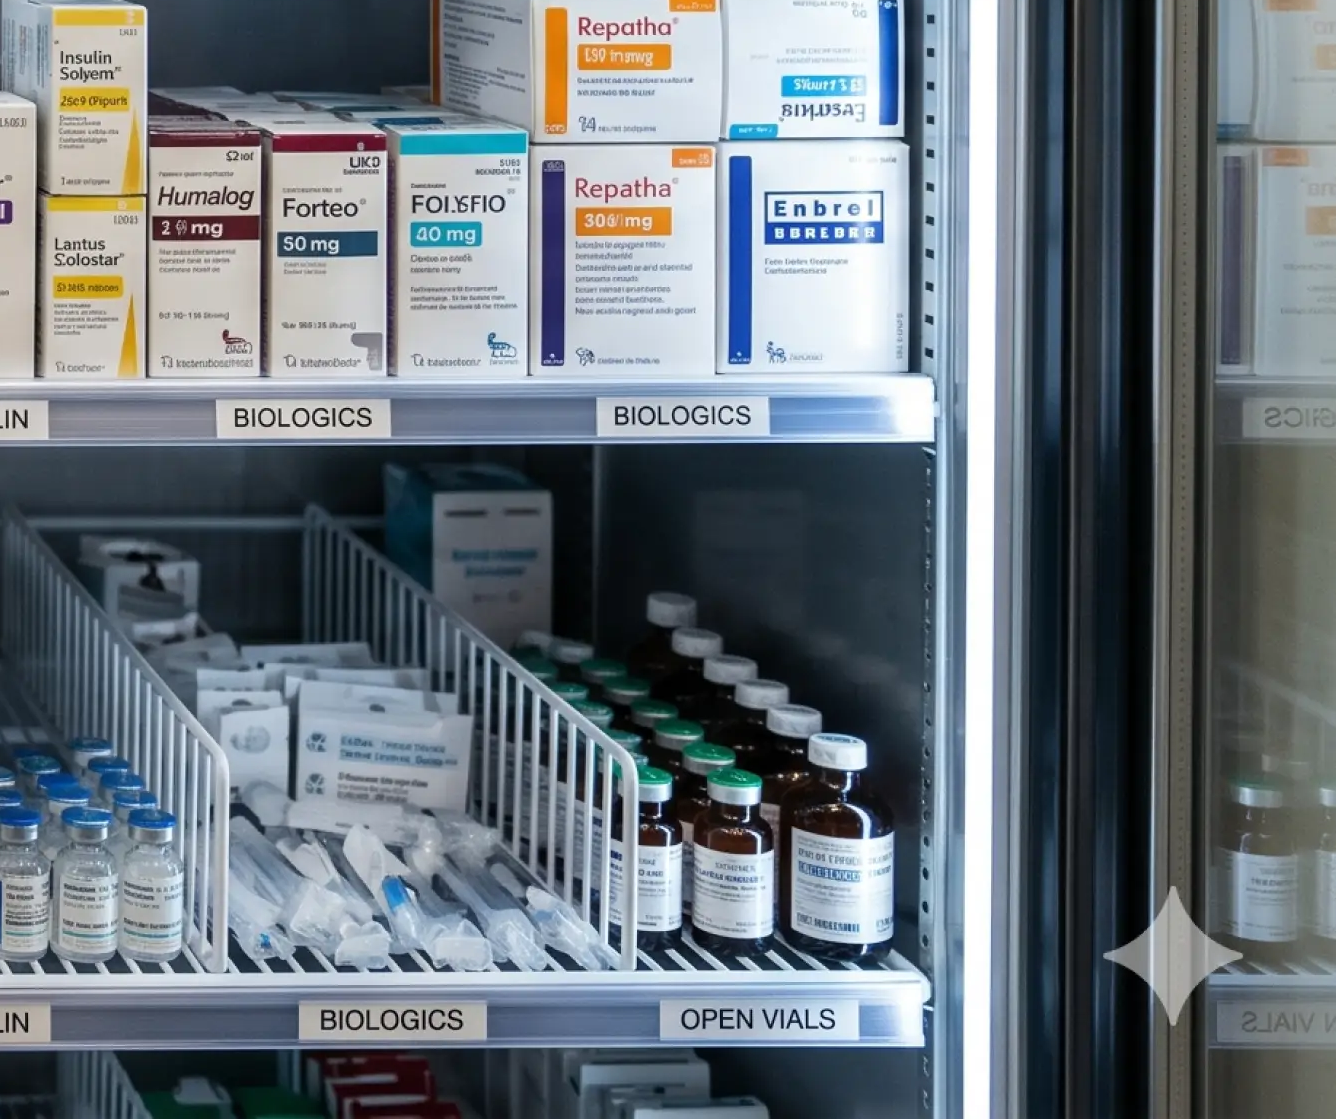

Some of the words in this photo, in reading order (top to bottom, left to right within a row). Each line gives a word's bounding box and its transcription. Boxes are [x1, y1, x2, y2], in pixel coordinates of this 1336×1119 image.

[578, 16, 672, 40] Repatha
[59, 50, 112, 65] Insulin
[157, 186, 255, 210] Humalog
[575, 177, 672, 203] Repatha
[282, 197, 359, 217] Forteo
[773, 199, 874, 217] Enbrel
[190, 222, 224, 238] mg
[446, 228, 476, 245] mg
[54, 238, 106, 251] Lantus
[310, 237, 340, 254] mg
[234, 407, 373, 428] BIOLOGICS
[614, 405, 752, 426] BIOLOGICS
[320, 1009, 464, 1031] BIOLOGICS
[681, 1008, 753, 1030] OPEN
[762, 1008, 836, 1030] VIALS
